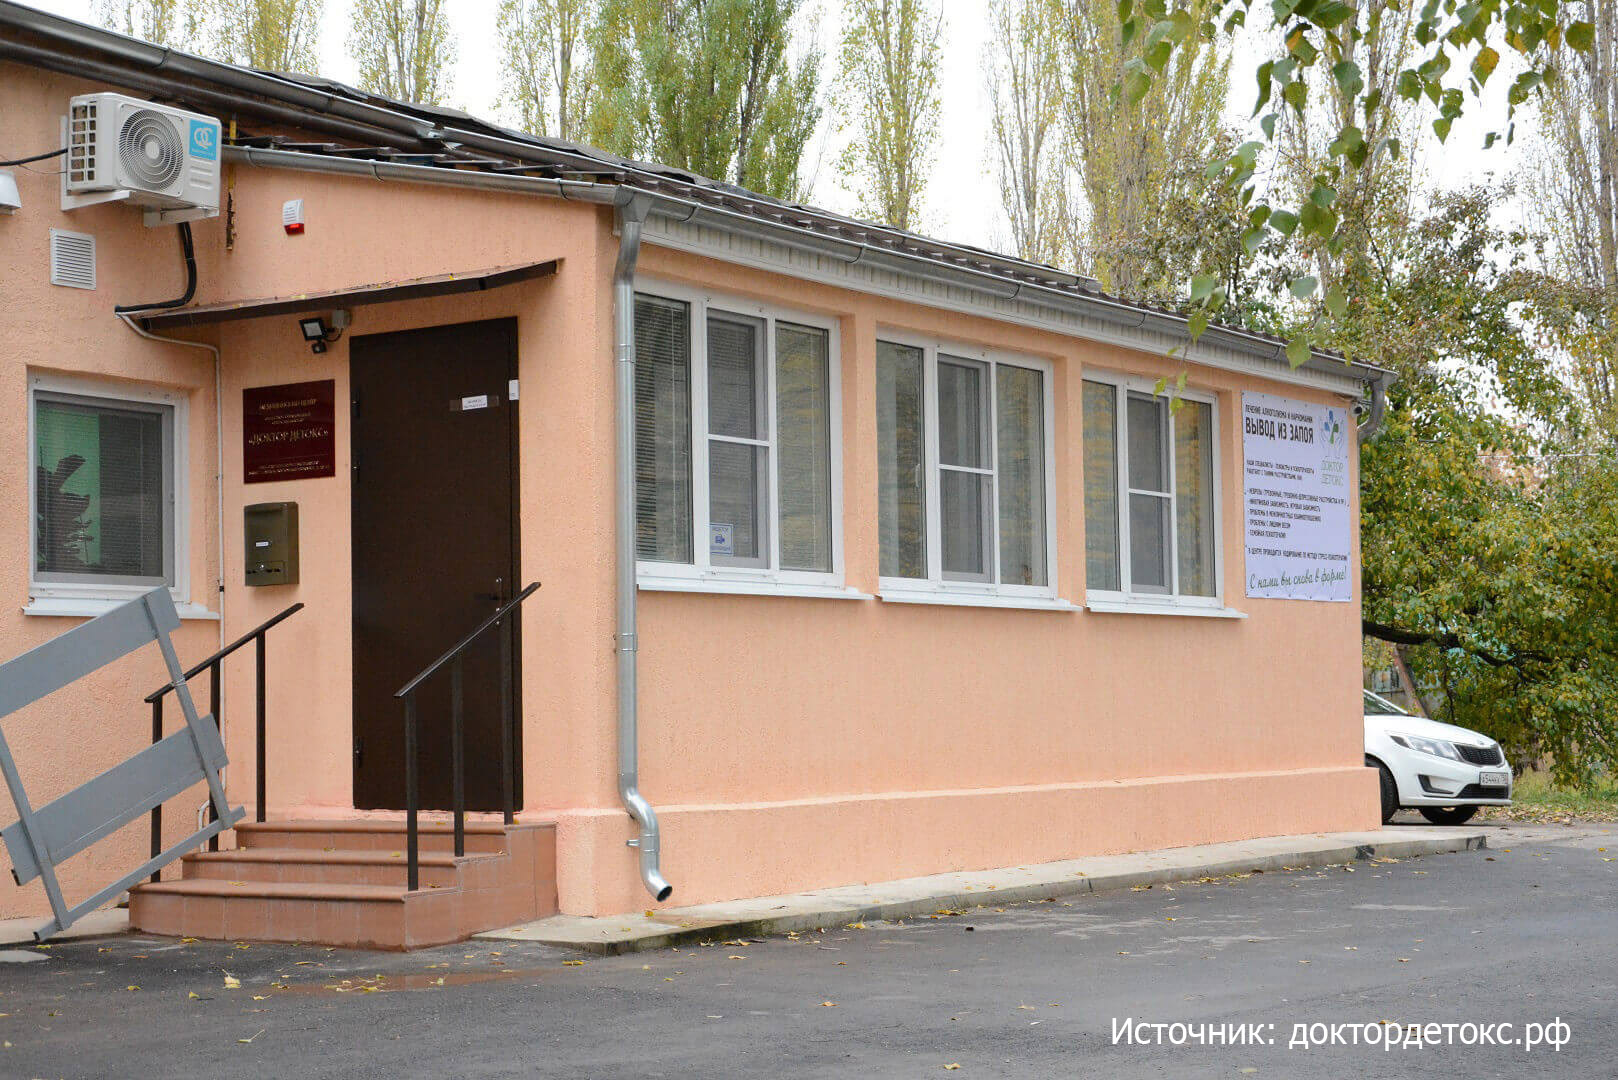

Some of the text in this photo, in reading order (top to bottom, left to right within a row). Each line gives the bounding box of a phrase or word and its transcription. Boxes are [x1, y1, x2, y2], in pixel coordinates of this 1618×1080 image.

[1245, 416, 1314, 444] ВЫВОД ИЗ ЗАПОЯ
[1250, 565, 1347, 589] С нами вы снова в форме!
